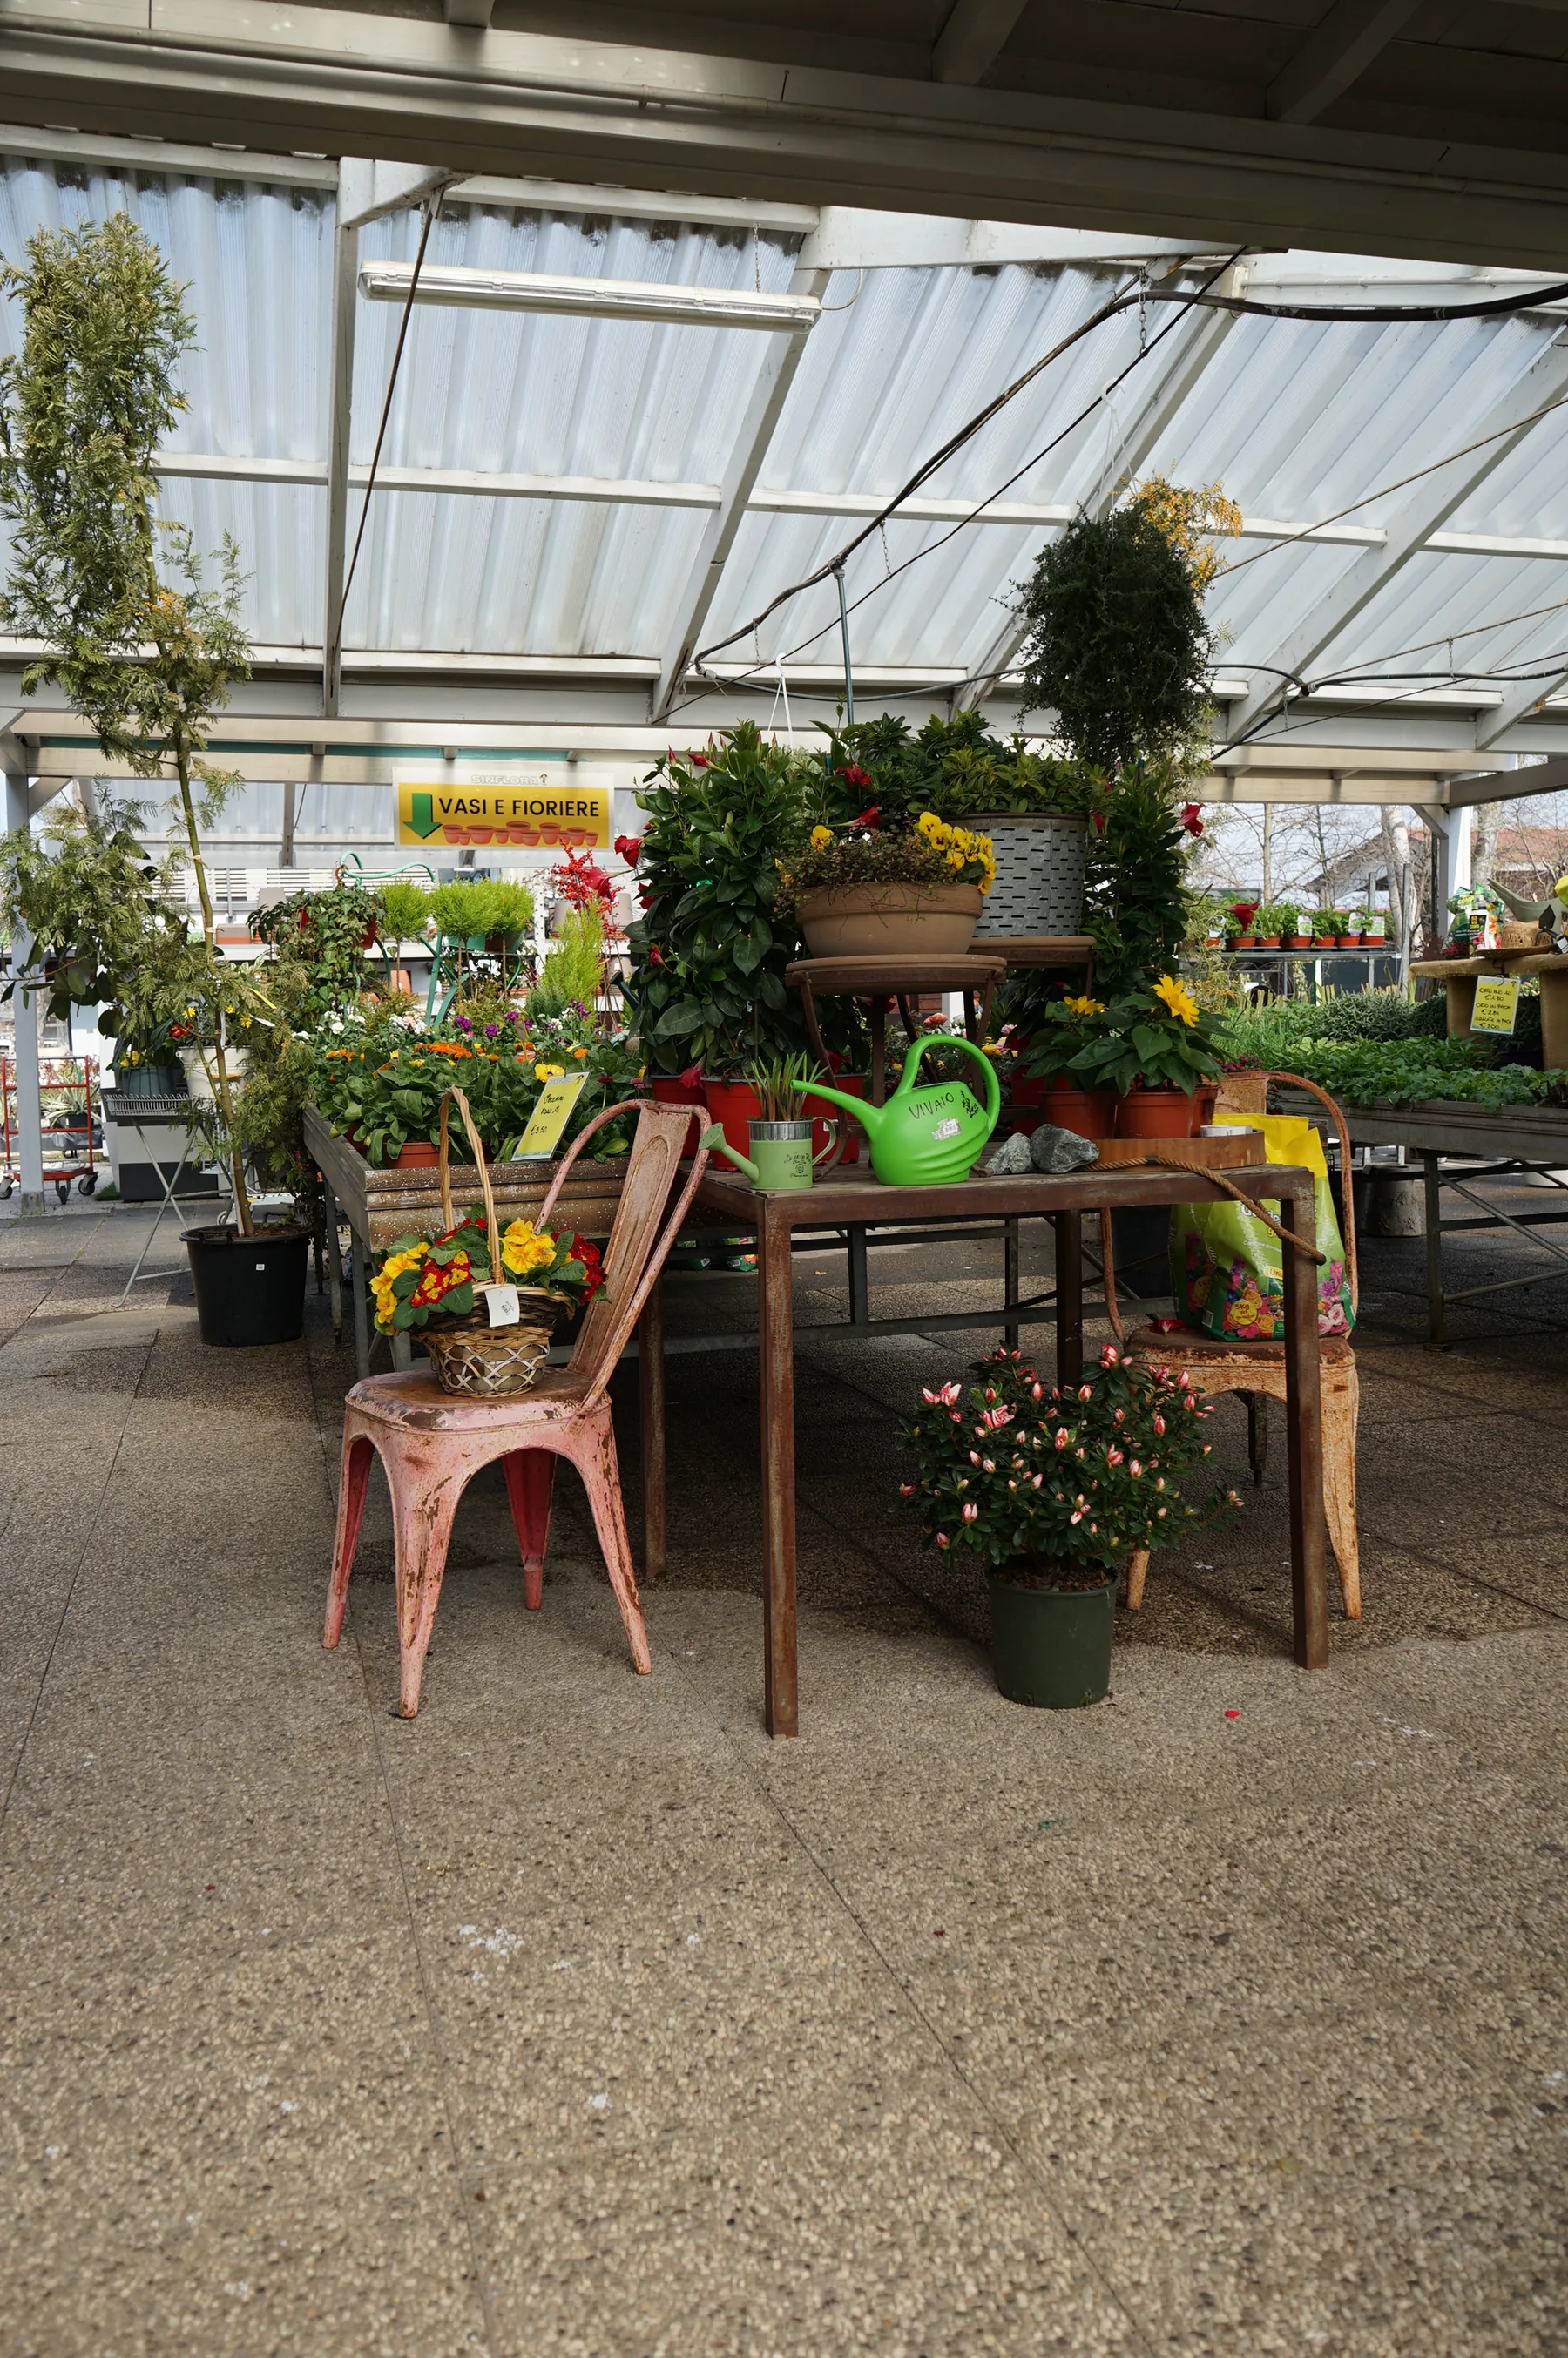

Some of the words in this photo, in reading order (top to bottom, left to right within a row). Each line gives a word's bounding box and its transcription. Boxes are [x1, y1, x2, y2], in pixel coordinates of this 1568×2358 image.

[471, 774, 538, 785] SINFLORA
[439, 798, 487, 814] VASI
[495, 800, 504, 814] E
[512, 800, 599, 817] FIORIERE
[1457, 895, 1474, 905] COMP
[909, 1092, 955, 1119] VIVAIO
